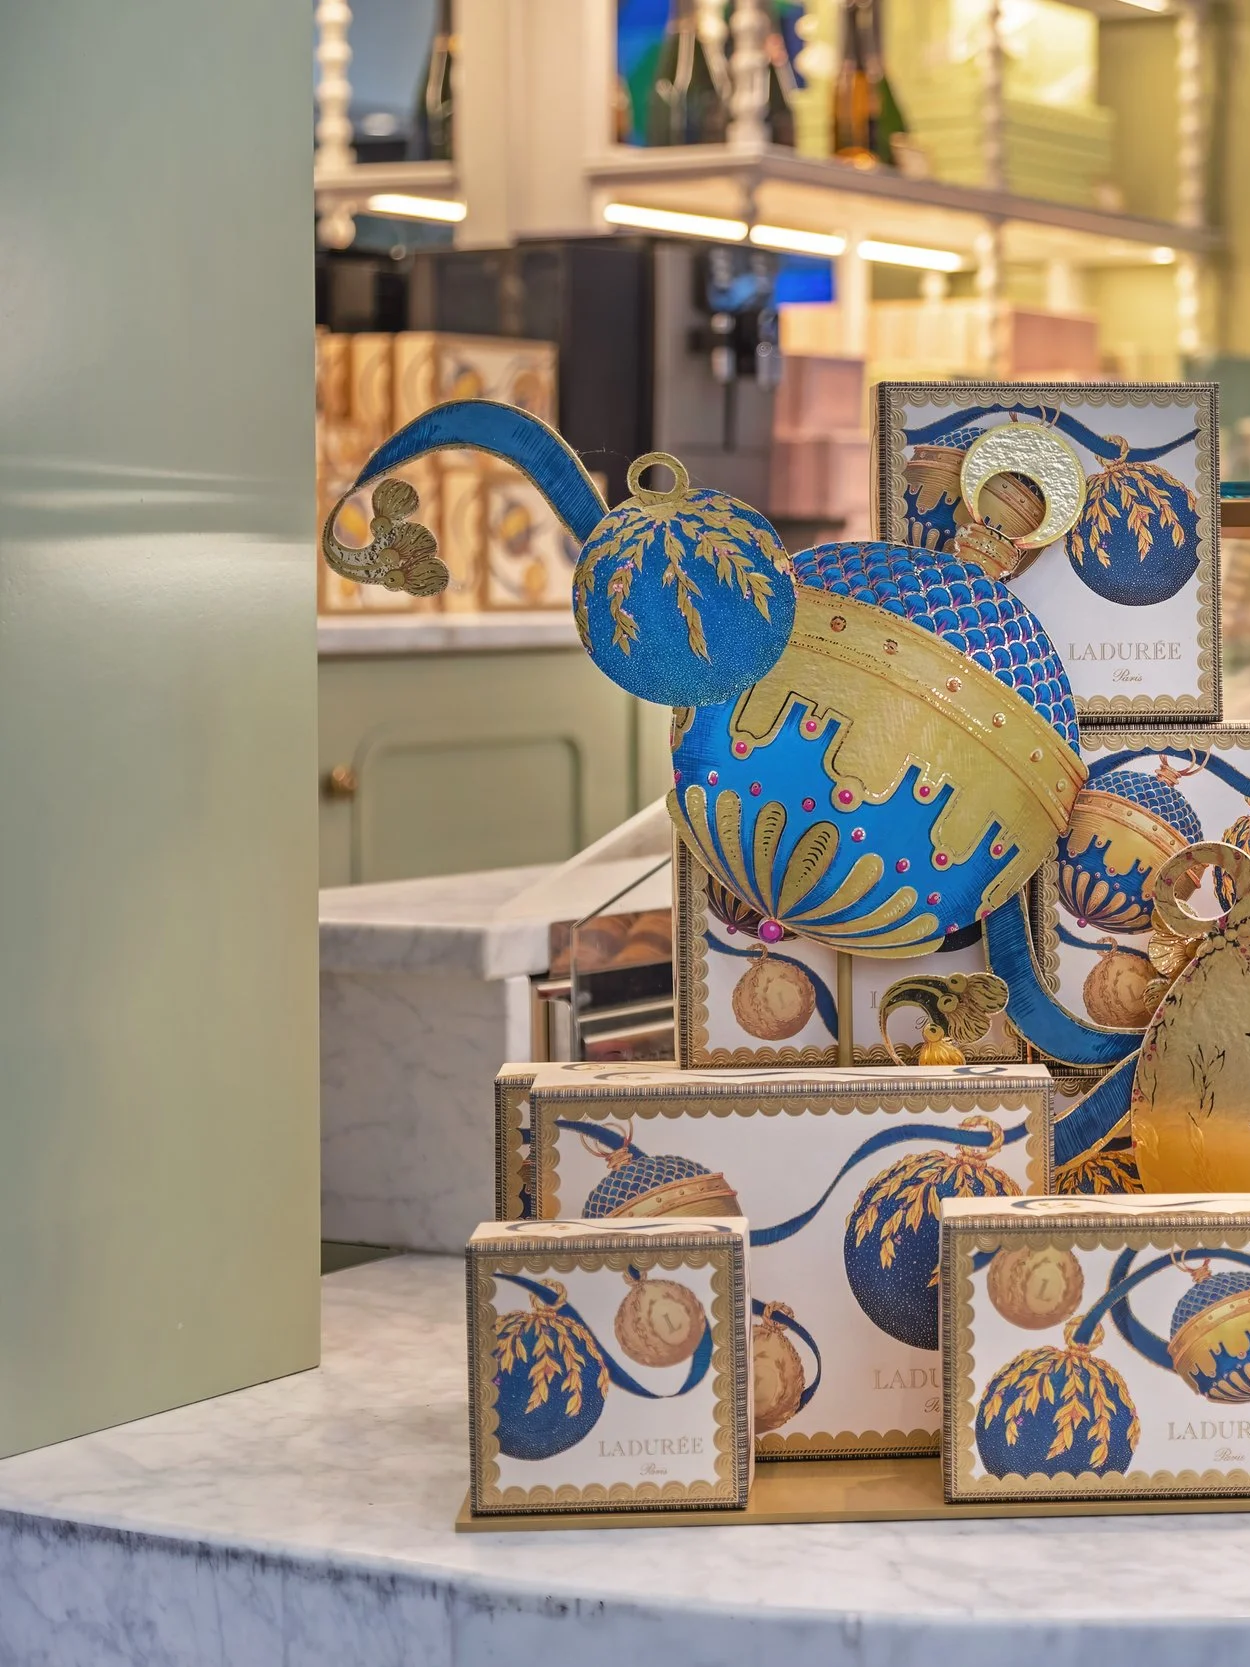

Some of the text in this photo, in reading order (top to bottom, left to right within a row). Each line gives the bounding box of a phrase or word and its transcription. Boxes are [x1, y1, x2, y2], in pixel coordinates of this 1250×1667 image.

[1067, 640, 1182, 661] LADURÉE
[1112, 668, 1143, 683] Paris
[872, 1367, 941, 1390] LADU
[598, 1436, 704, 1458] LADURÉE
